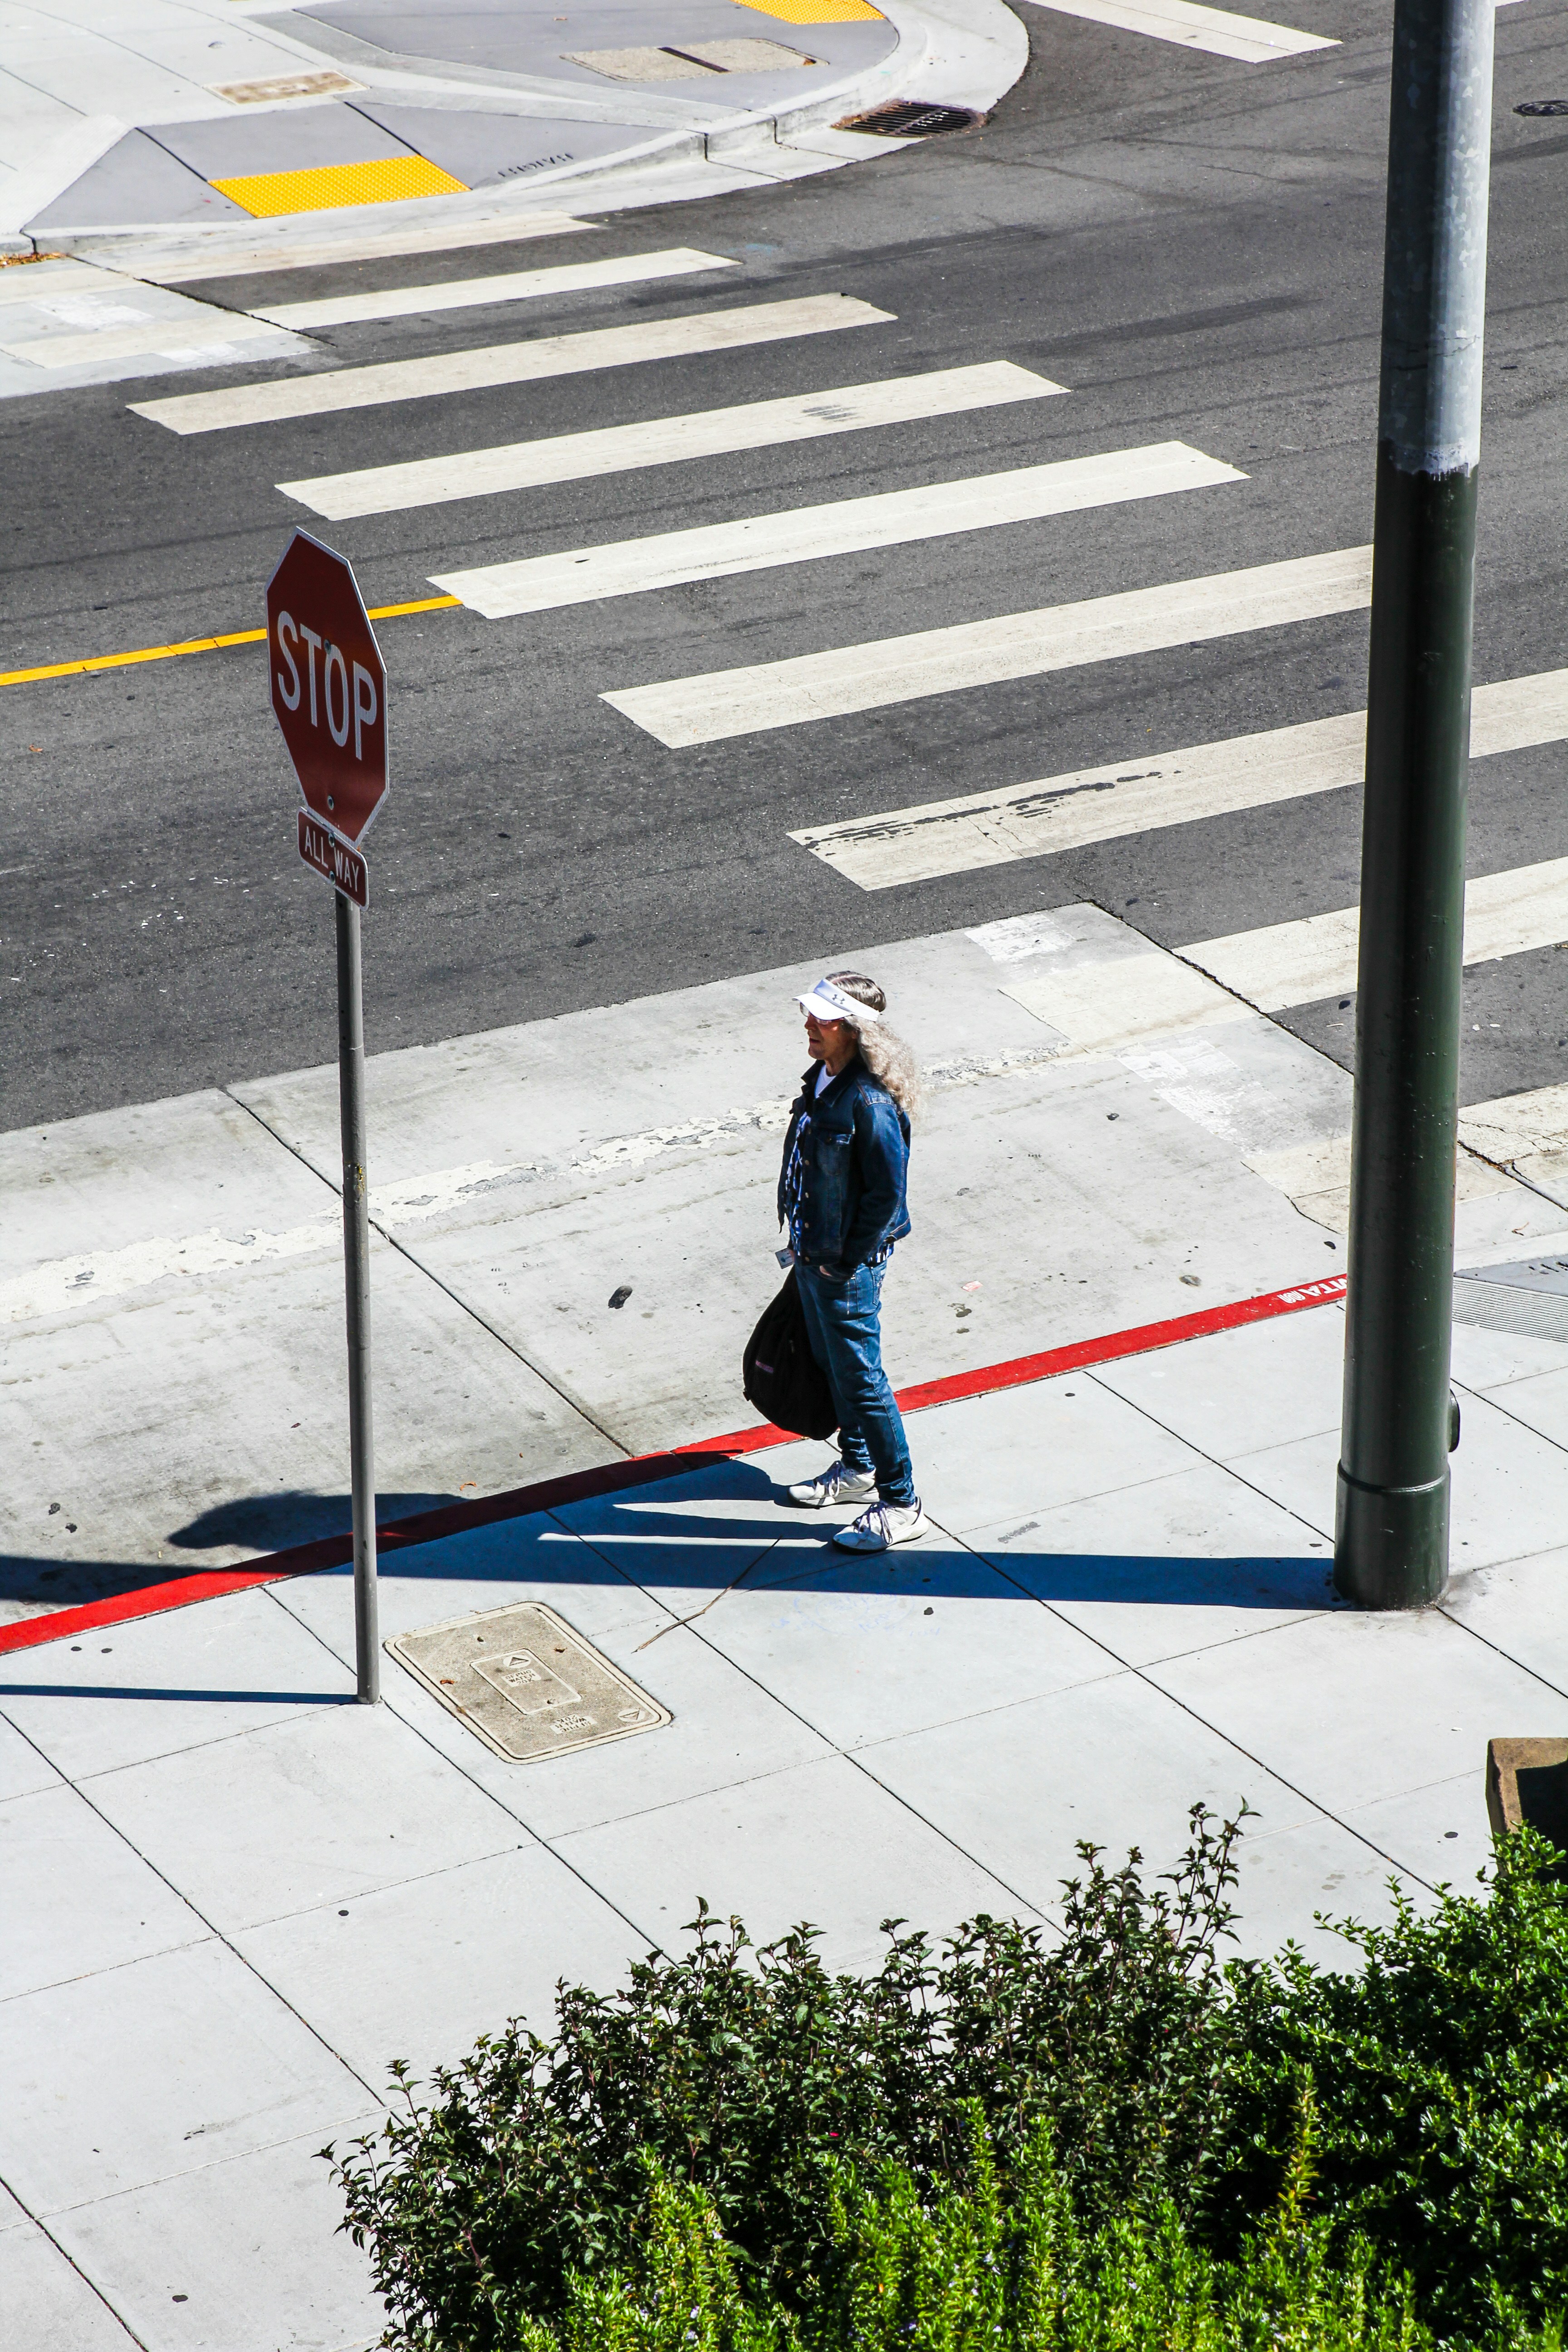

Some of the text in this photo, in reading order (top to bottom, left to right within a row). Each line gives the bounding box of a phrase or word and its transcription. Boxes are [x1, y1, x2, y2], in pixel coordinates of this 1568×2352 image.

[277, 611, 377, 761] STOP
[305, 826, 359, 892] ALL WAY
